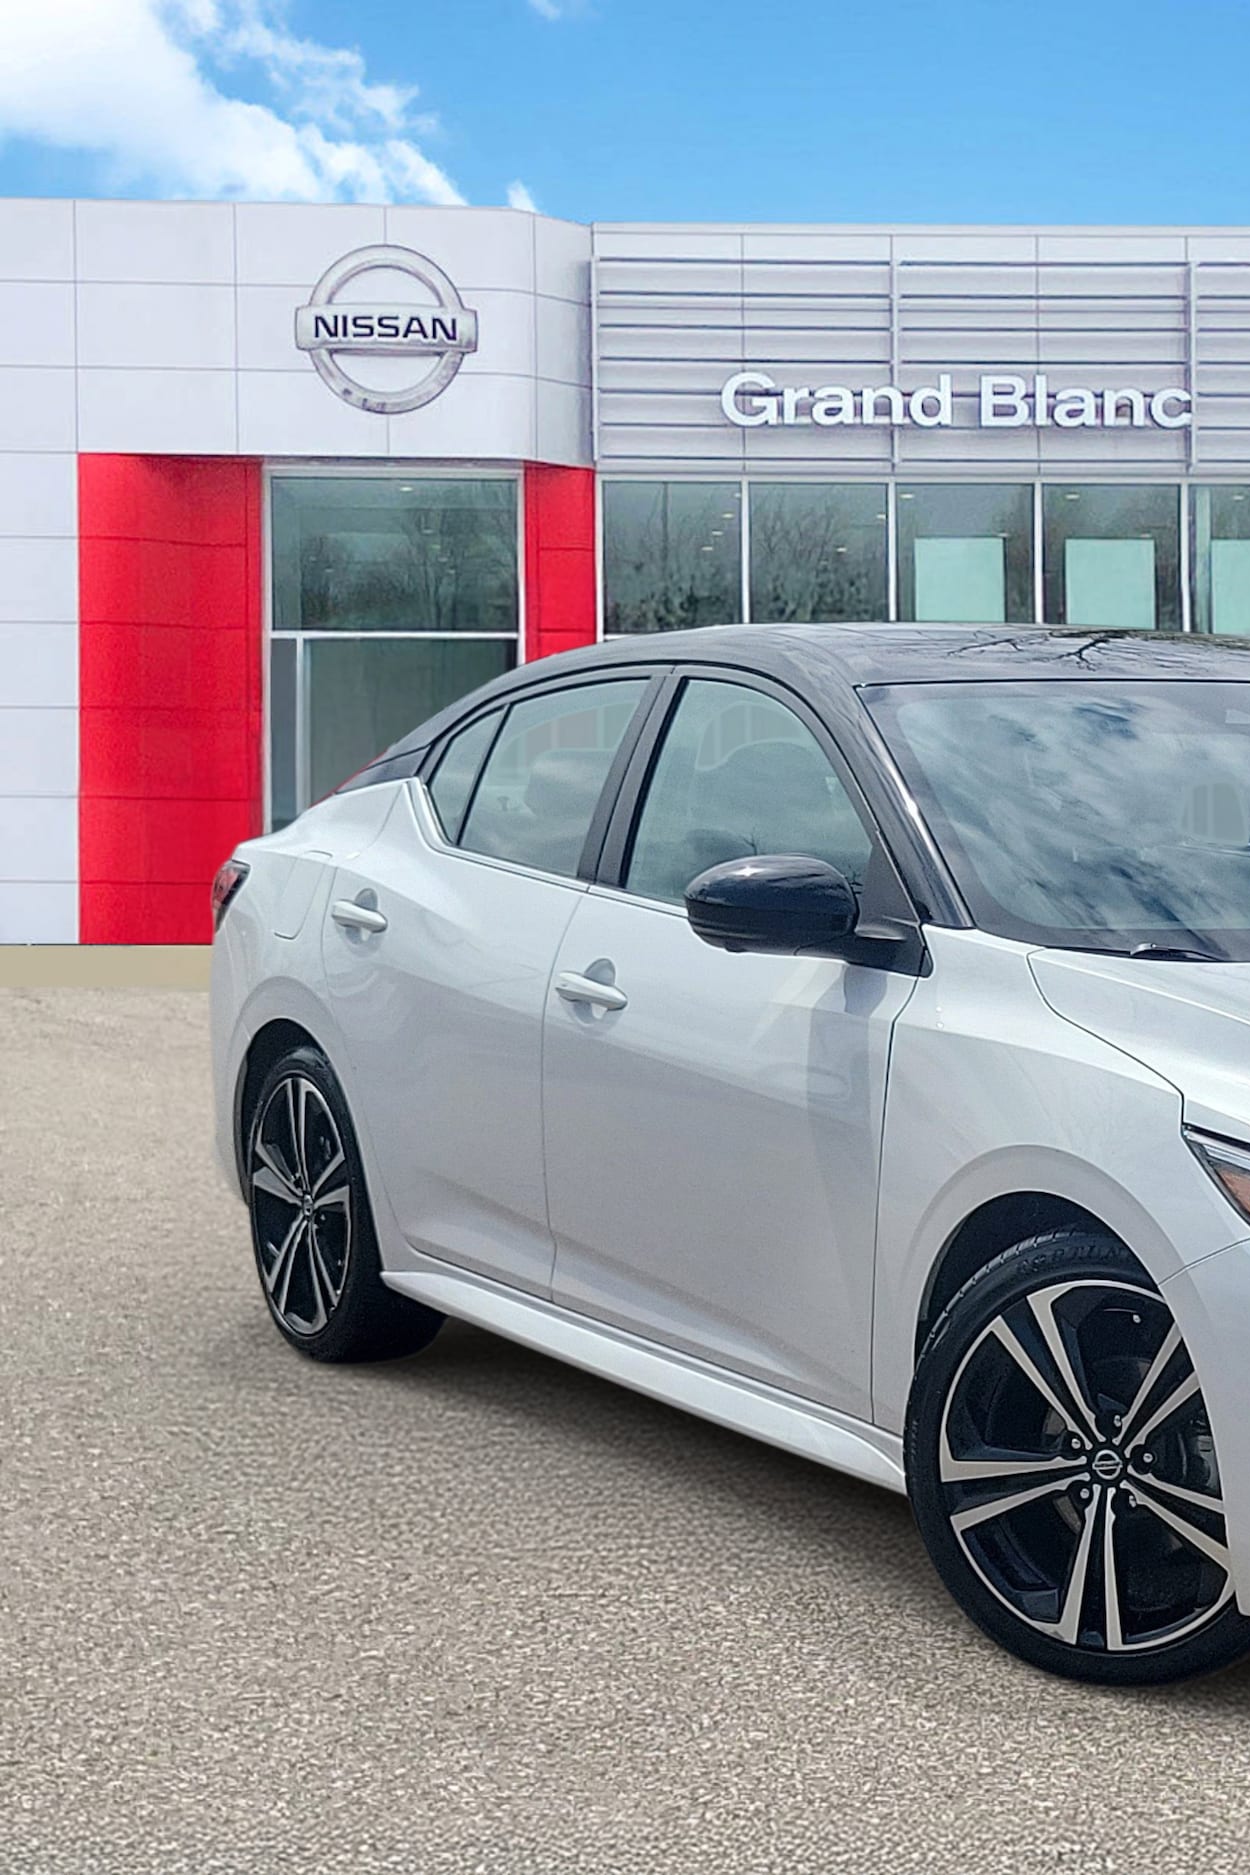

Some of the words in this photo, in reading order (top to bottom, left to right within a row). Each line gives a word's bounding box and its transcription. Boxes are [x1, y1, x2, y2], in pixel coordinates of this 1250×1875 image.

[314, 314, 457, 341] NISSAN
[721, 372, 952, 427] Grand
[980, 374, 1193, 429] Blanc
